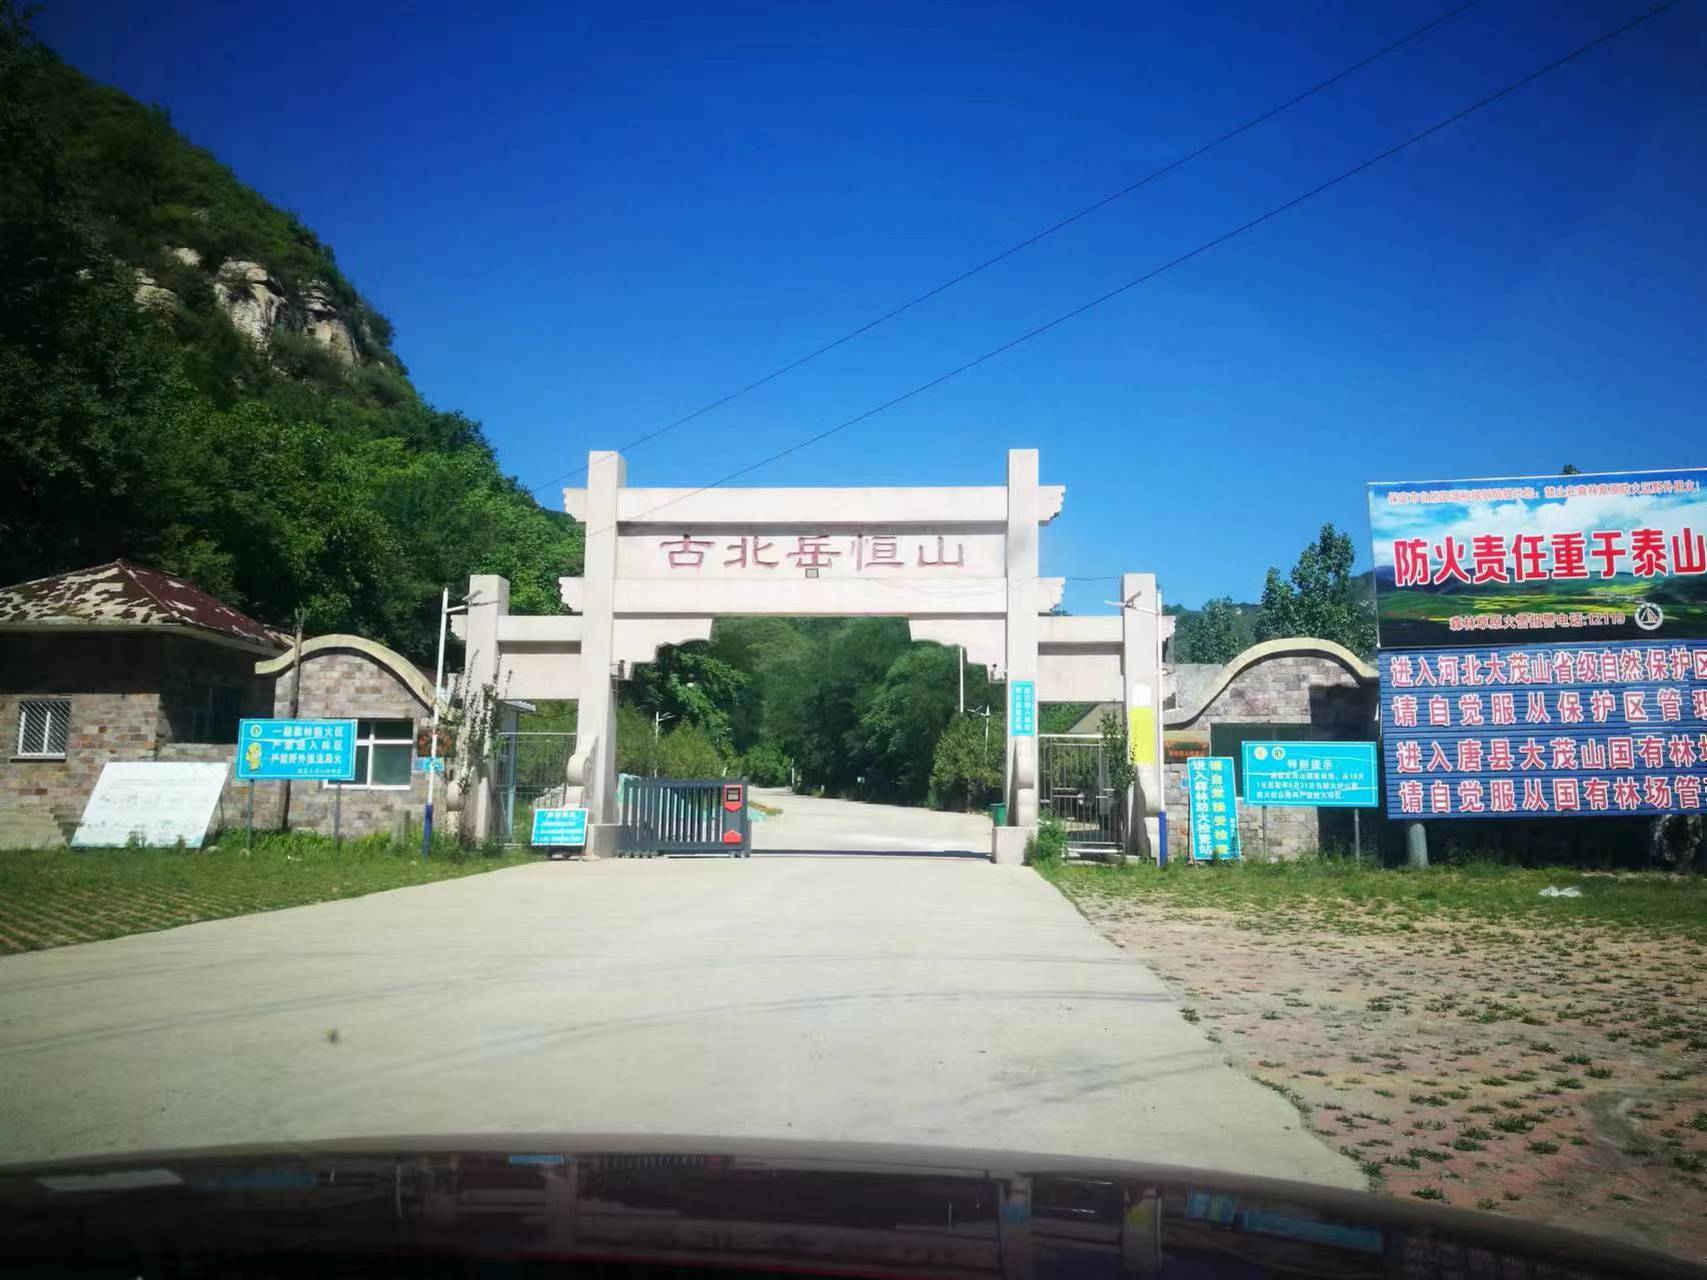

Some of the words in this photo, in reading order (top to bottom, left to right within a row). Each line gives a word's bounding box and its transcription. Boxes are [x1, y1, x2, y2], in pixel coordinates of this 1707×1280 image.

[660, 535, 965, 571] 古北岳恒山
[1393, 527, 1707, 587] 防火责任重于泰山
[1390, 648, 1707, 688] 进入河北大茂山省级自然保护区
[1398, 775, 1707, 815] 请自觉服从国有林场管
